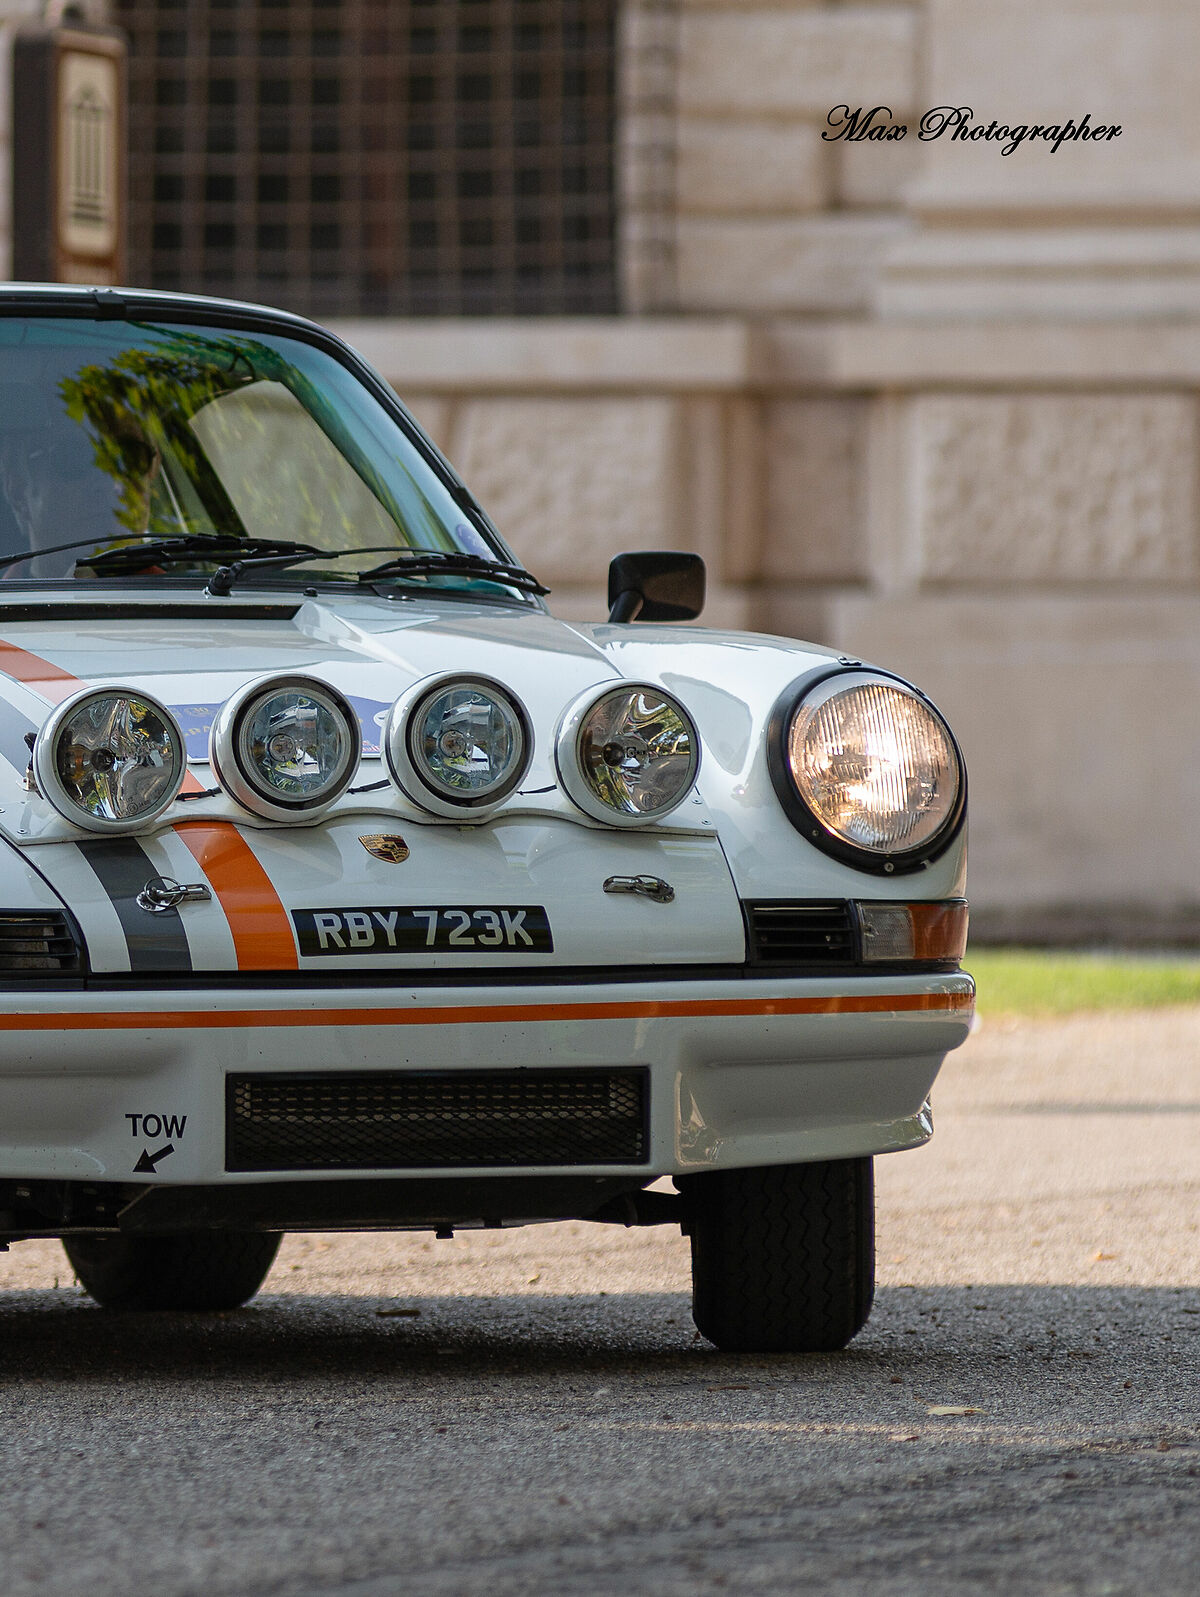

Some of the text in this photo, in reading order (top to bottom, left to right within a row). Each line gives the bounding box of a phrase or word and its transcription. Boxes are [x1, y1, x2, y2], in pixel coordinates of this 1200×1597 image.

[313, 909, 534, 950] RBY 723K
[124, 1113, 188, 1139] TOW
